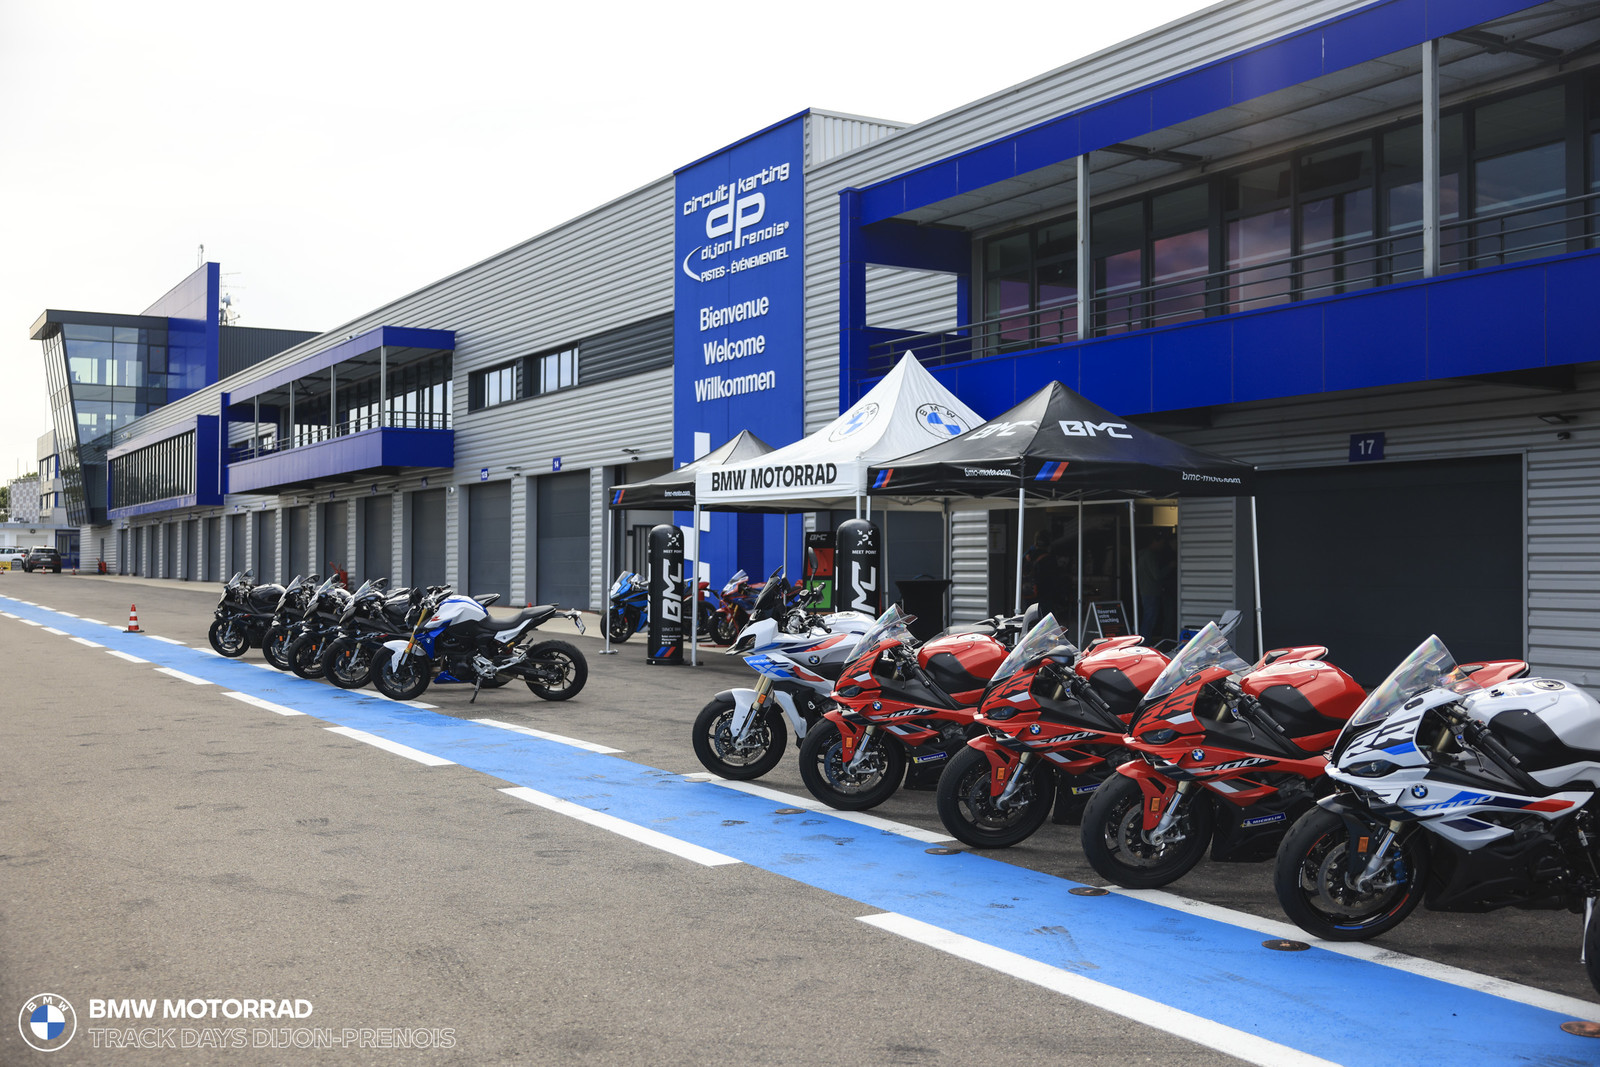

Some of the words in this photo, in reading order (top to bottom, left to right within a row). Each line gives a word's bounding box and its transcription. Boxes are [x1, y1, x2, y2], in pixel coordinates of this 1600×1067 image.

[683, 184, 729, 216] circuit
[737, 162, 790, 195] karting
[700, 240, 733, 261] dijon
[700, 265, 726, 283] PISTES
[700, 296, 770, 332] Bienvenue
[703, 334, 766, 366] Welcome
[694, 370, 776, 403] Willkommen
[1058, 420, 1134, 440] BMC
[1358, 439, 1375, 455] 17
[711, 469, 747, 492] BMW
[750, 462, 838, 489] MOTORRAD
[662, 558, 682, 623] BMC
[851, 560, 876, 619] MC
